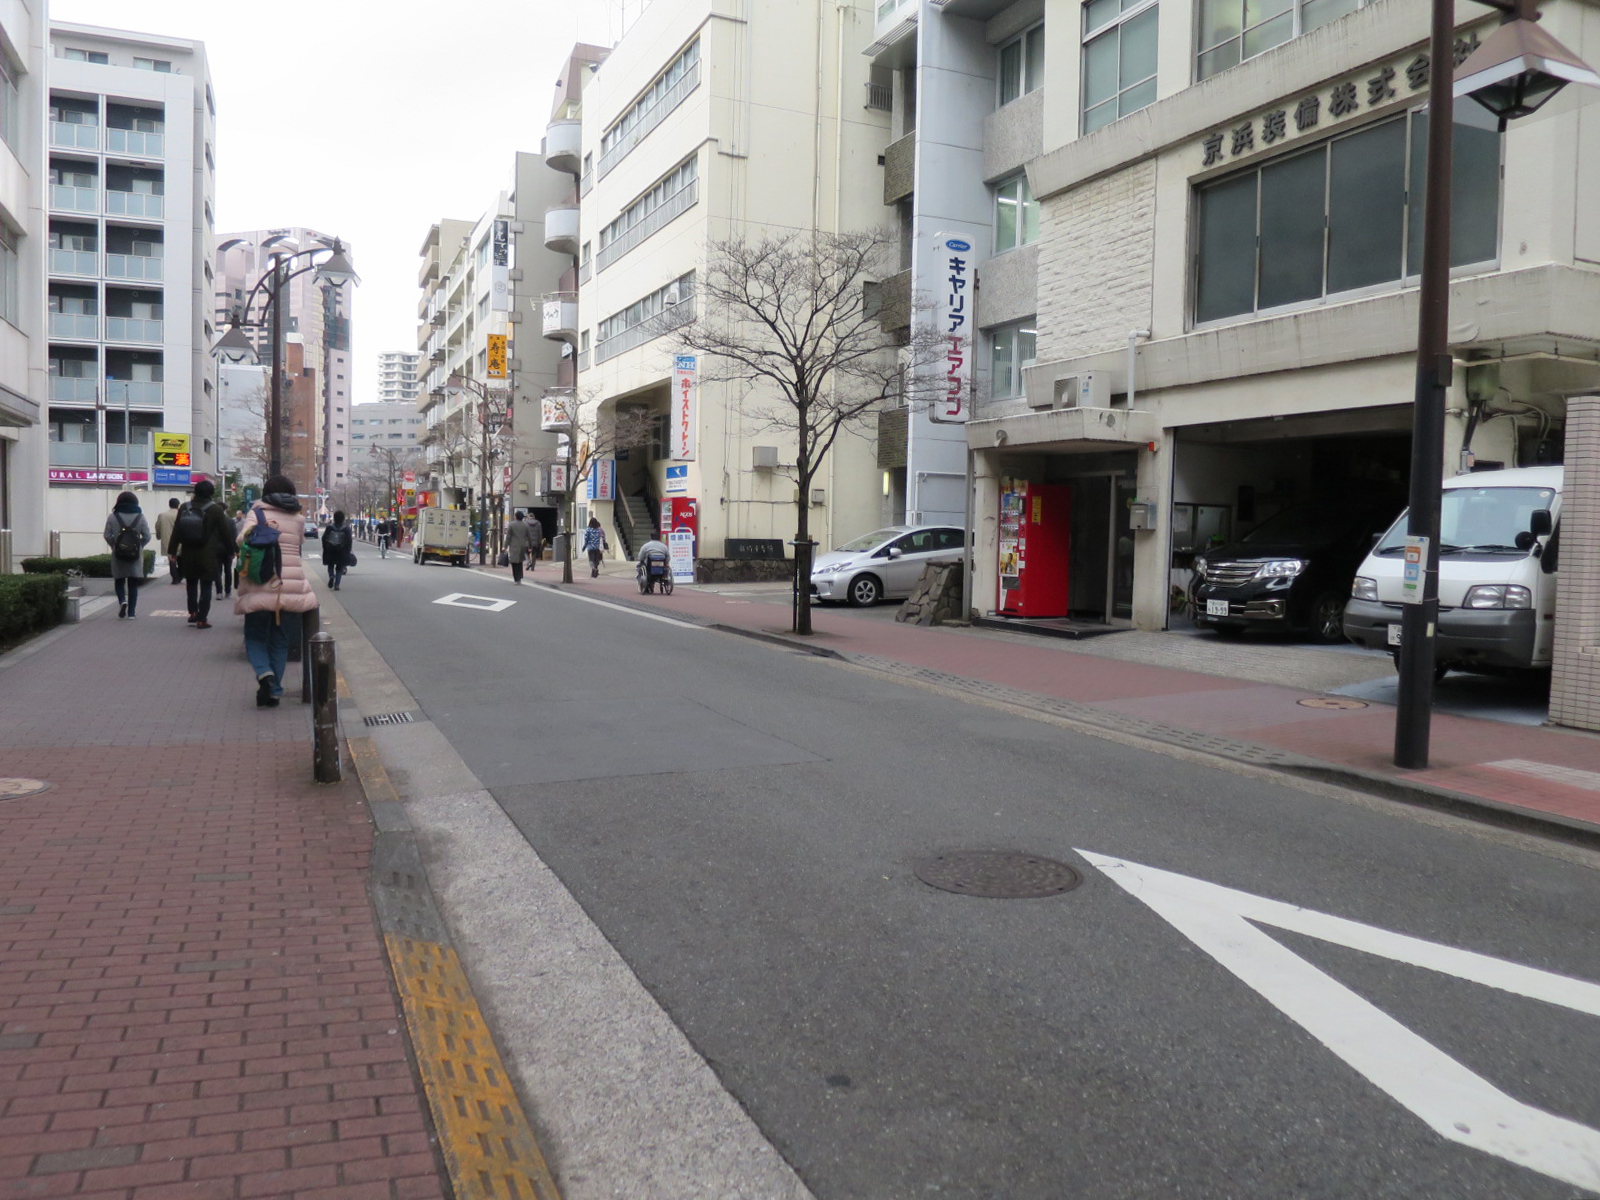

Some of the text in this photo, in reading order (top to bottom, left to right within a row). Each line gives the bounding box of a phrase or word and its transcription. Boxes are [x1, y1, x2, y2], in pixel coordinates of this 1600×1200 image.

[948, 241, 969, 249] Carrier
[682, 378, 691, 457] ホイストクレーン
[86, 472, 123, 480] LAWSON
